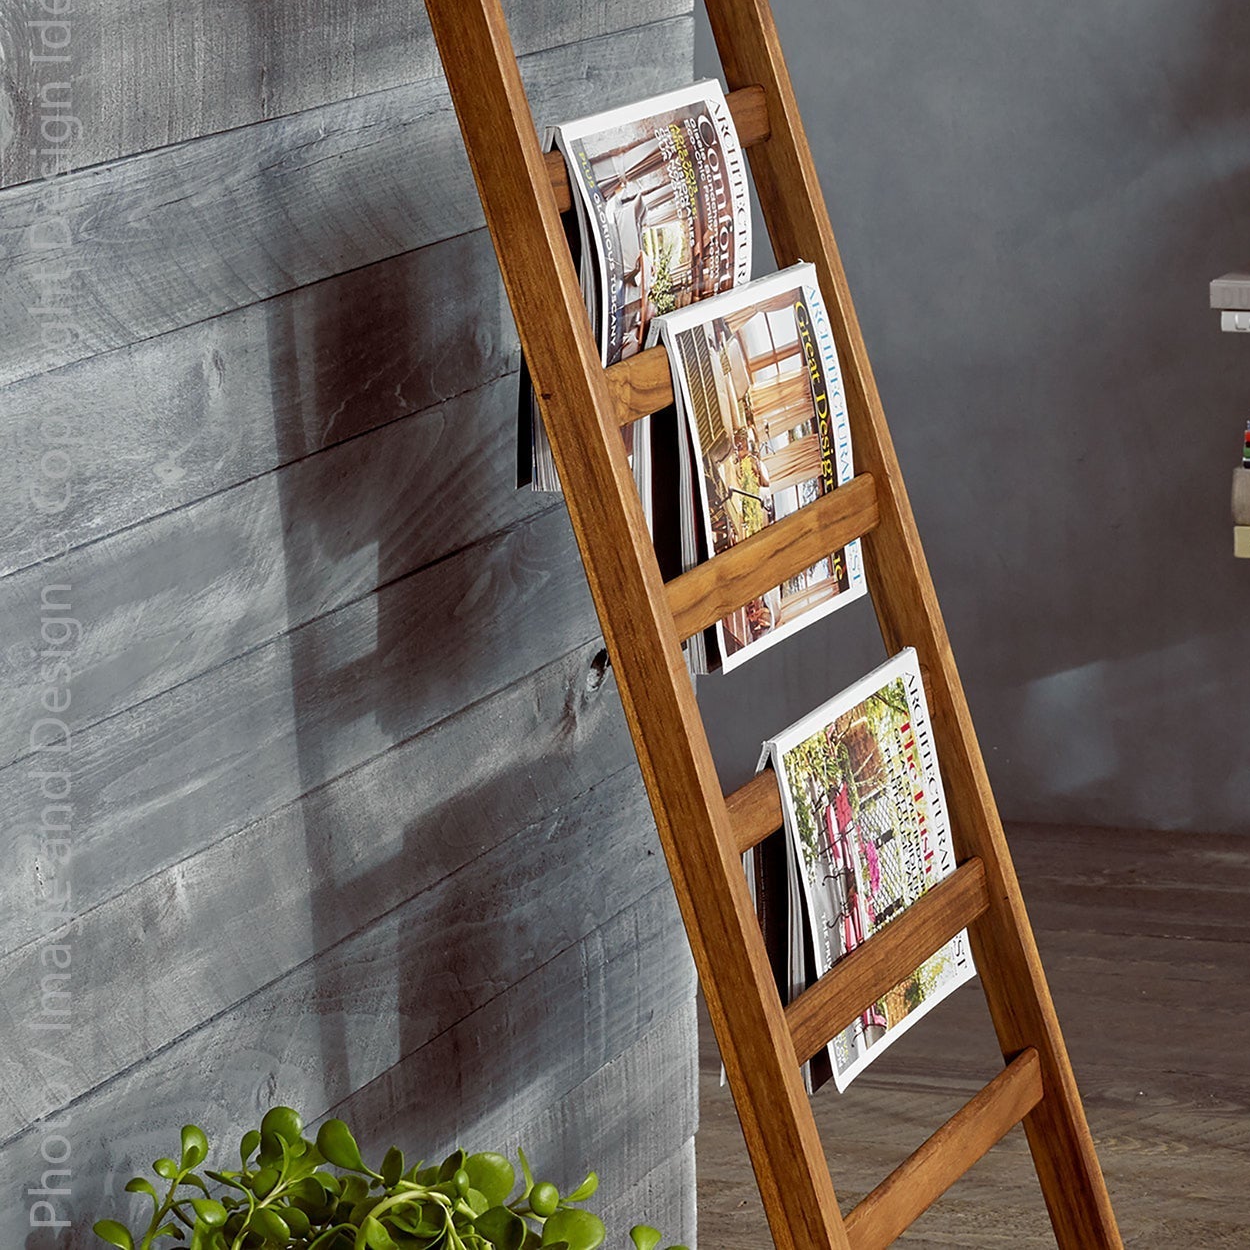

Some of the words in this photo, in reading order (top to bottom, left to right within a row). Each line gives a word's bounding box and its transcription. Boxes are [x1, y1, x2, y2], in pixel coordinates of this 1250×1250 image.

[682, 160, 698, 194] 2013
[689, 117, 707, 161] Gisele
[683, 119, 707, 182] Eco-Chic
[702, 184, 714, 231] Family
[708, 235, 716, 280] Home
[697, 114, 733, 284] Comfort
[578, 152, 594, 189] PLUS
[593, 192, 615, 271] GLORIOUS
[609, 276, 617, 346] TUSCANY
[794, 301, 821, 385] Great
[893, 727, 908, 776] GREAT
[905, 780, 917, 823] STYLE
[900, 711, 918, 783] The
[884, 747, 908, 851] PENTHOUSE
